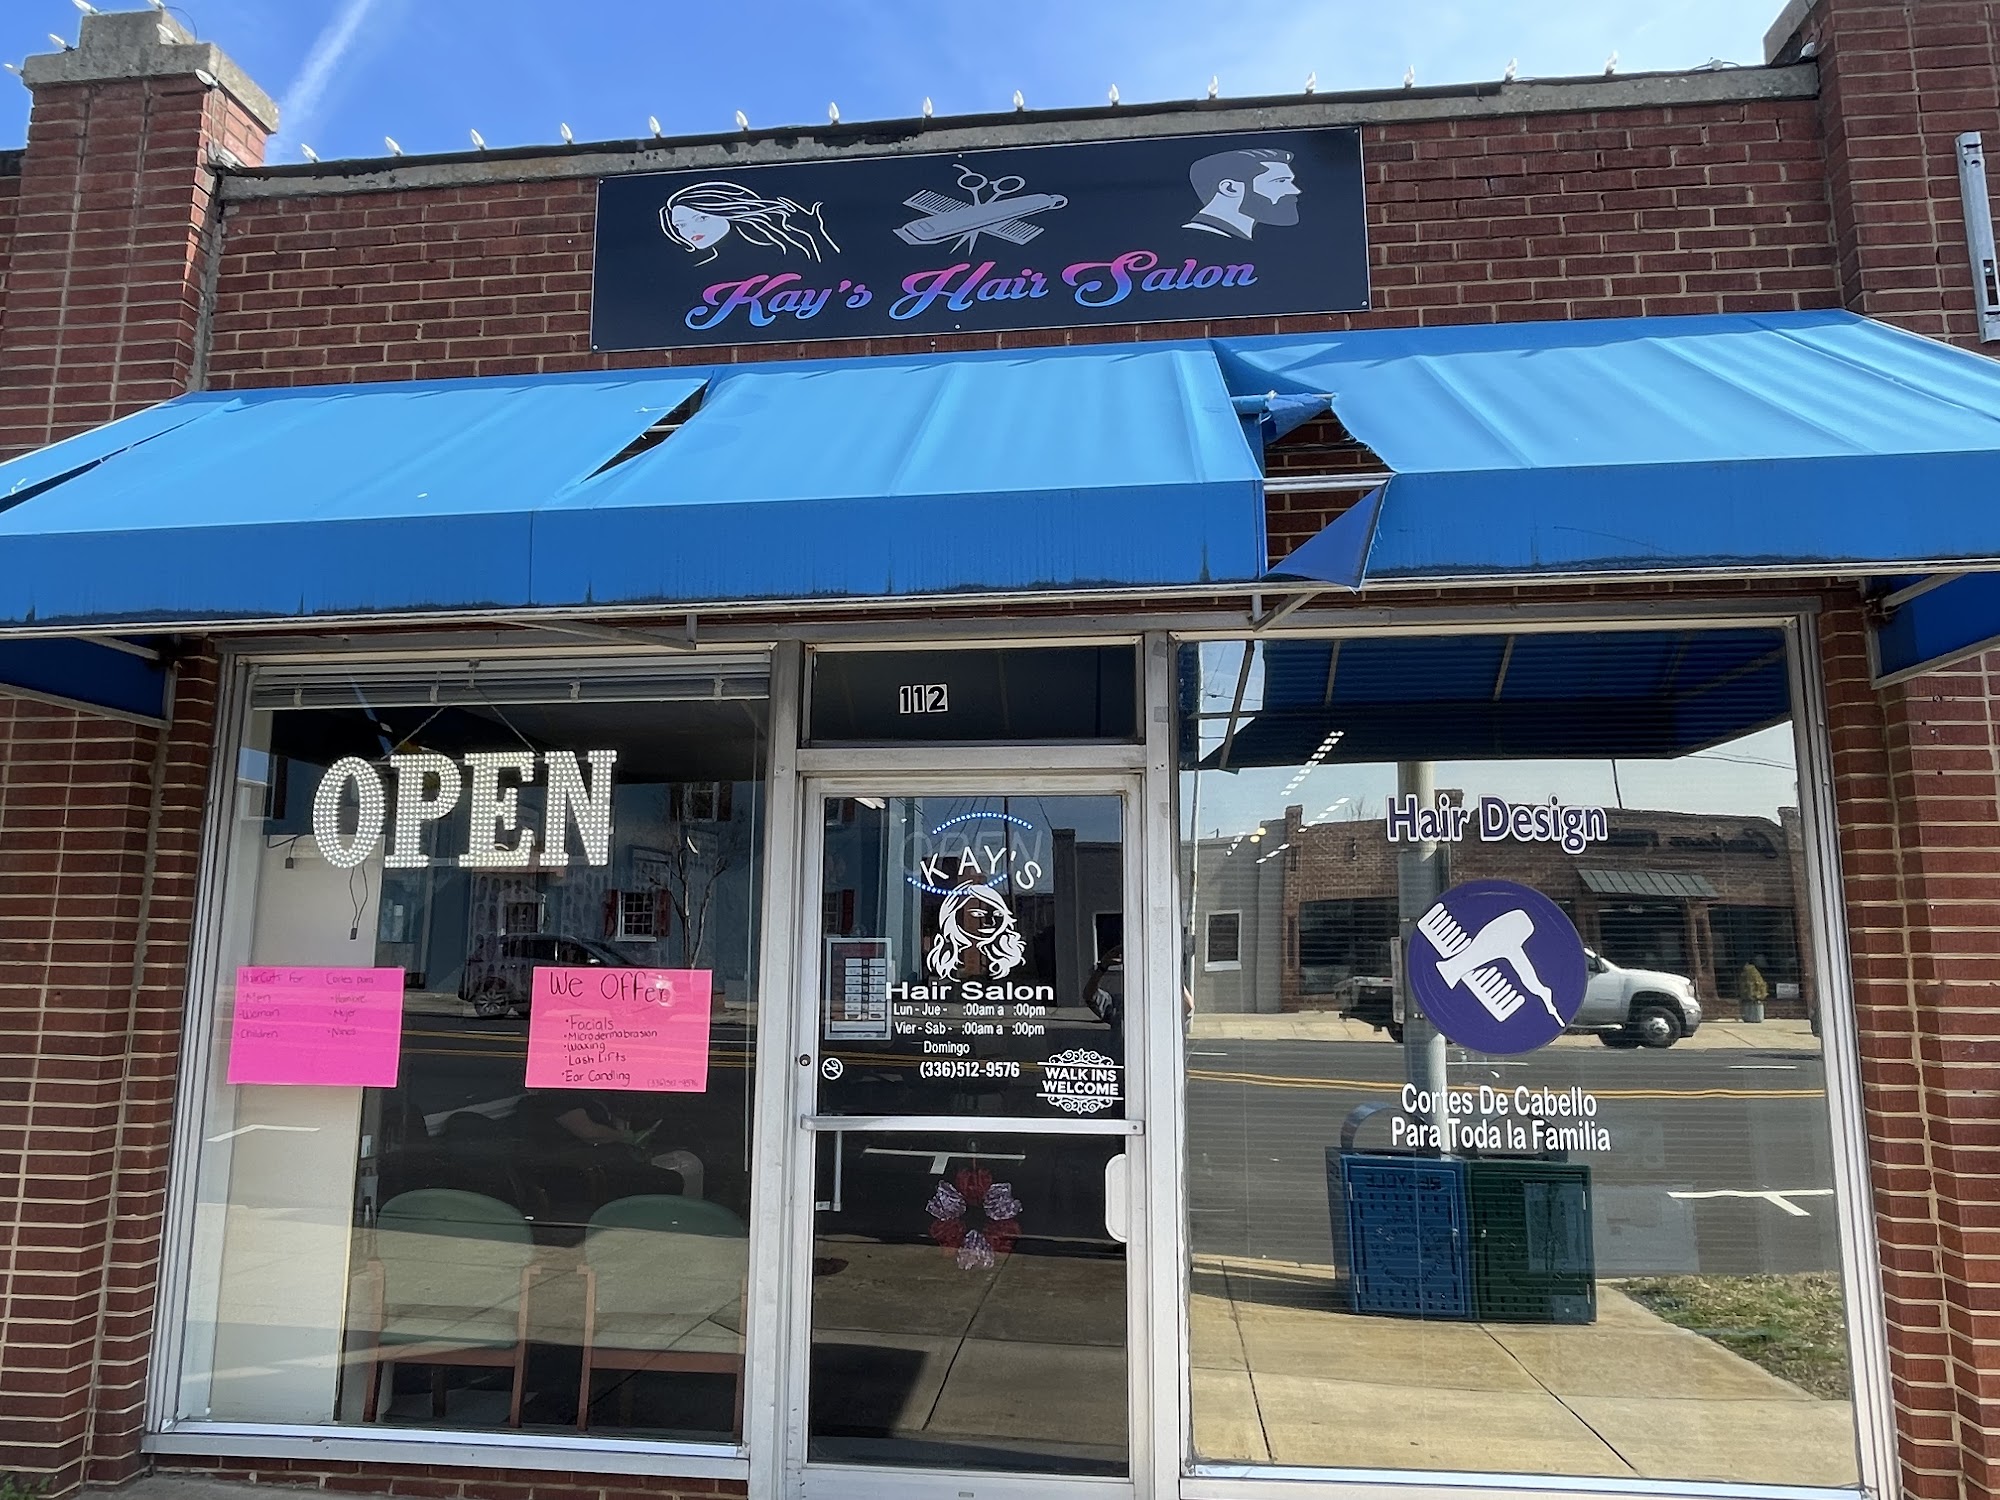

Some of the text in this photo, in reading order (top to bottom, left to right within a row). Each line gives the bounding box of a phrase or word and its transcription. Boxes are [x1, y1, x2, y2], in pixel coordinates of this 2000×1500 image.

[685, 250, 1258, 330] Kay's Hair Salon
[900, 684, 948, 713] 112
[313, 748, 618, 869] OPEN
[1386, 793, 1471, 842] Hair
[1478, 793, 1608, 854] Design
[920, 845, 1042, 889] KAY'S
[550, 971, 583, 997] We
[885, 981, 1054, 1000] Hair Salon
[893, 1003, 913, 1016] Lun
[921, 1003, 941, 1016] Jue
[962, 1003, 995, 1016] :00am
[997, 1006, 1005, 1016] a
[1013, 1003, 1046, 1018] :00pm
[570, 1014, 614, 1030] Facials
[895, 1022, 917, 1034] Vier
[925, 1022, 946, 1035] Sab
[961, 1022, 994, 1035] :00am
[996, 1026, 1004, 1035] a
[1011, 1022, 1045, 1037] :00pm
[568, 1029, 657, 1041] Microdermabrasion
[567, 1042, 606, 1053] Waxing
[923, 1040, 970, 1056] Domingo
[568, 1054, 594, 1066] Lash
[565, 1069, 584, 1082] Ear
[920, 1061, 1020, 1078] (336)512-9576
[1045, 1067, 1117, 1082] WALK INS
[1042, 1080, 1119, 1096] WELCOME
[1401, 1082, 1597, 1116] Cortes De Cabello
[1391, 1116, 1611, 1151] Para Toda la Familia
